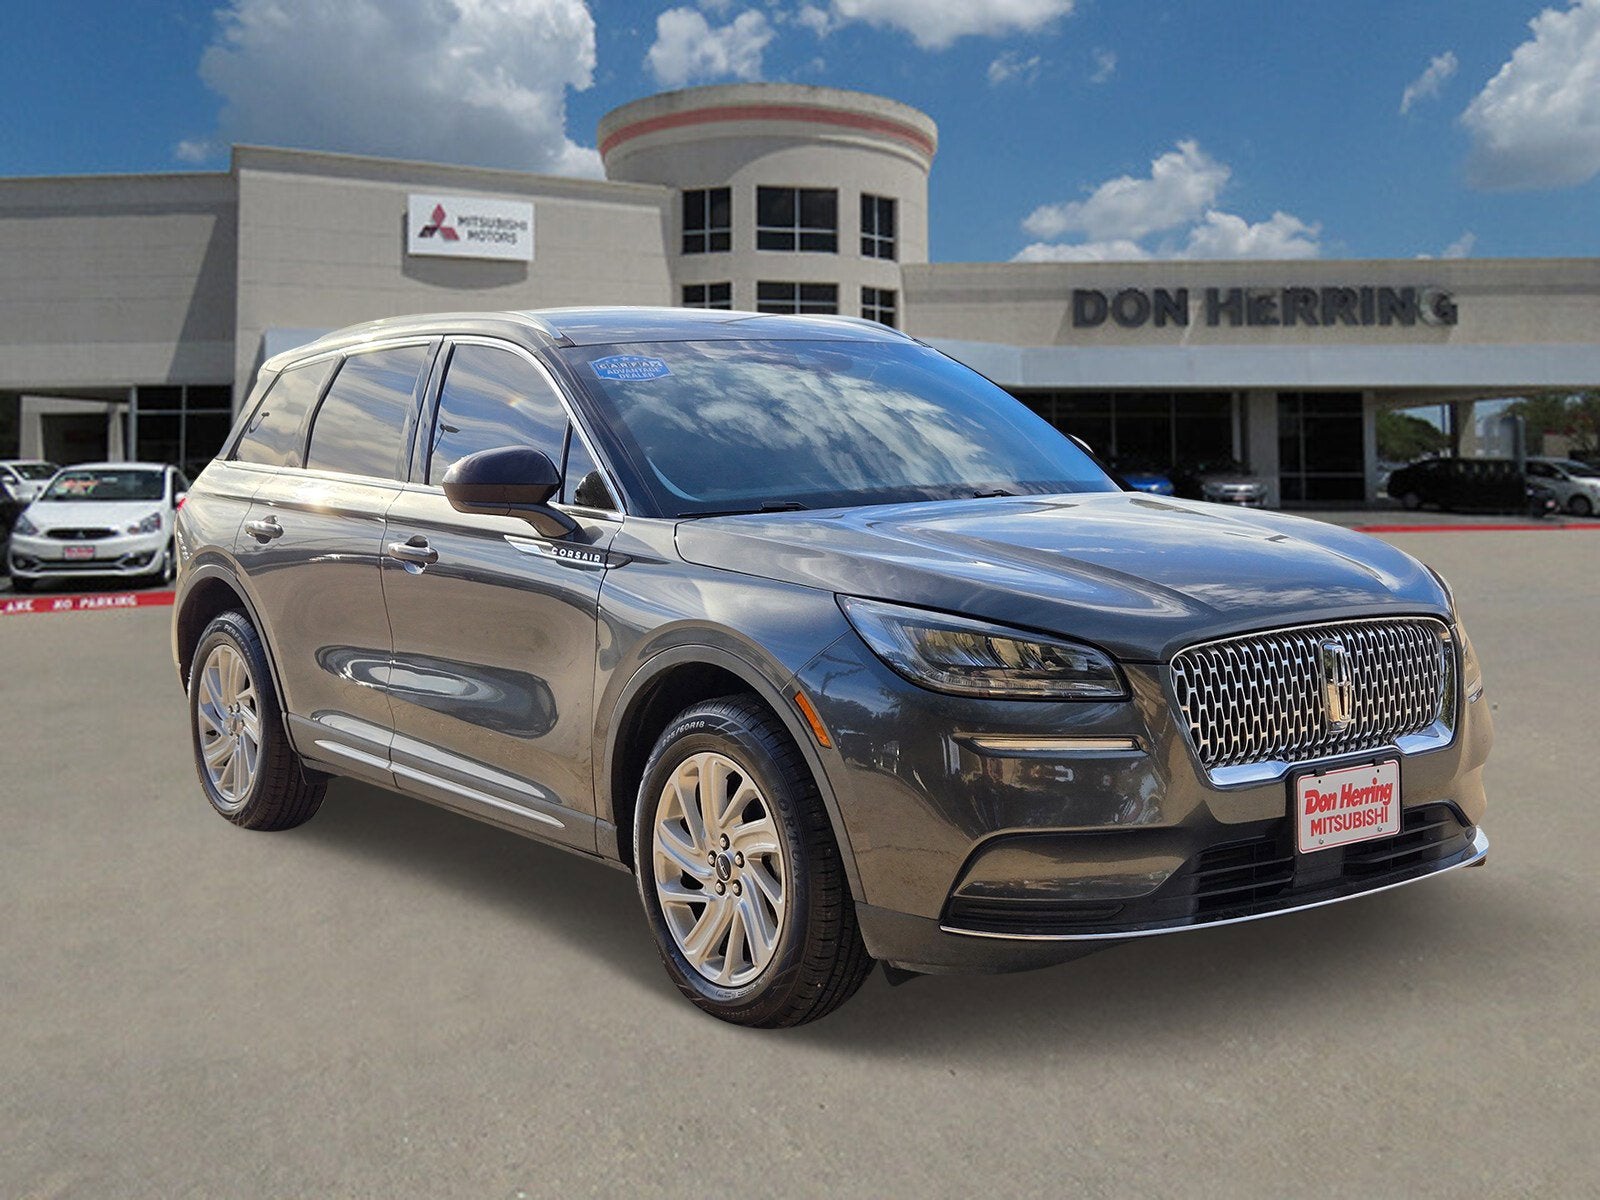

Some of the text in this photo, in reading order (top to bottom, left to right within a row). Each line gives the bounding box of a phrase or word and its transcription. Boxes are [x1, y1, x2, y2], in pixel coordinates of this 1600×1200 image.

[467, 231, 517, 244] MOTORS
[1072, 286, 1458, 328] DON HERRING
[551, 546, 600, 562] CORSAIR
[1304, 777, 1393, 815] Don Herring
[1310, 806, 1388, 837] MITSUBISHI
